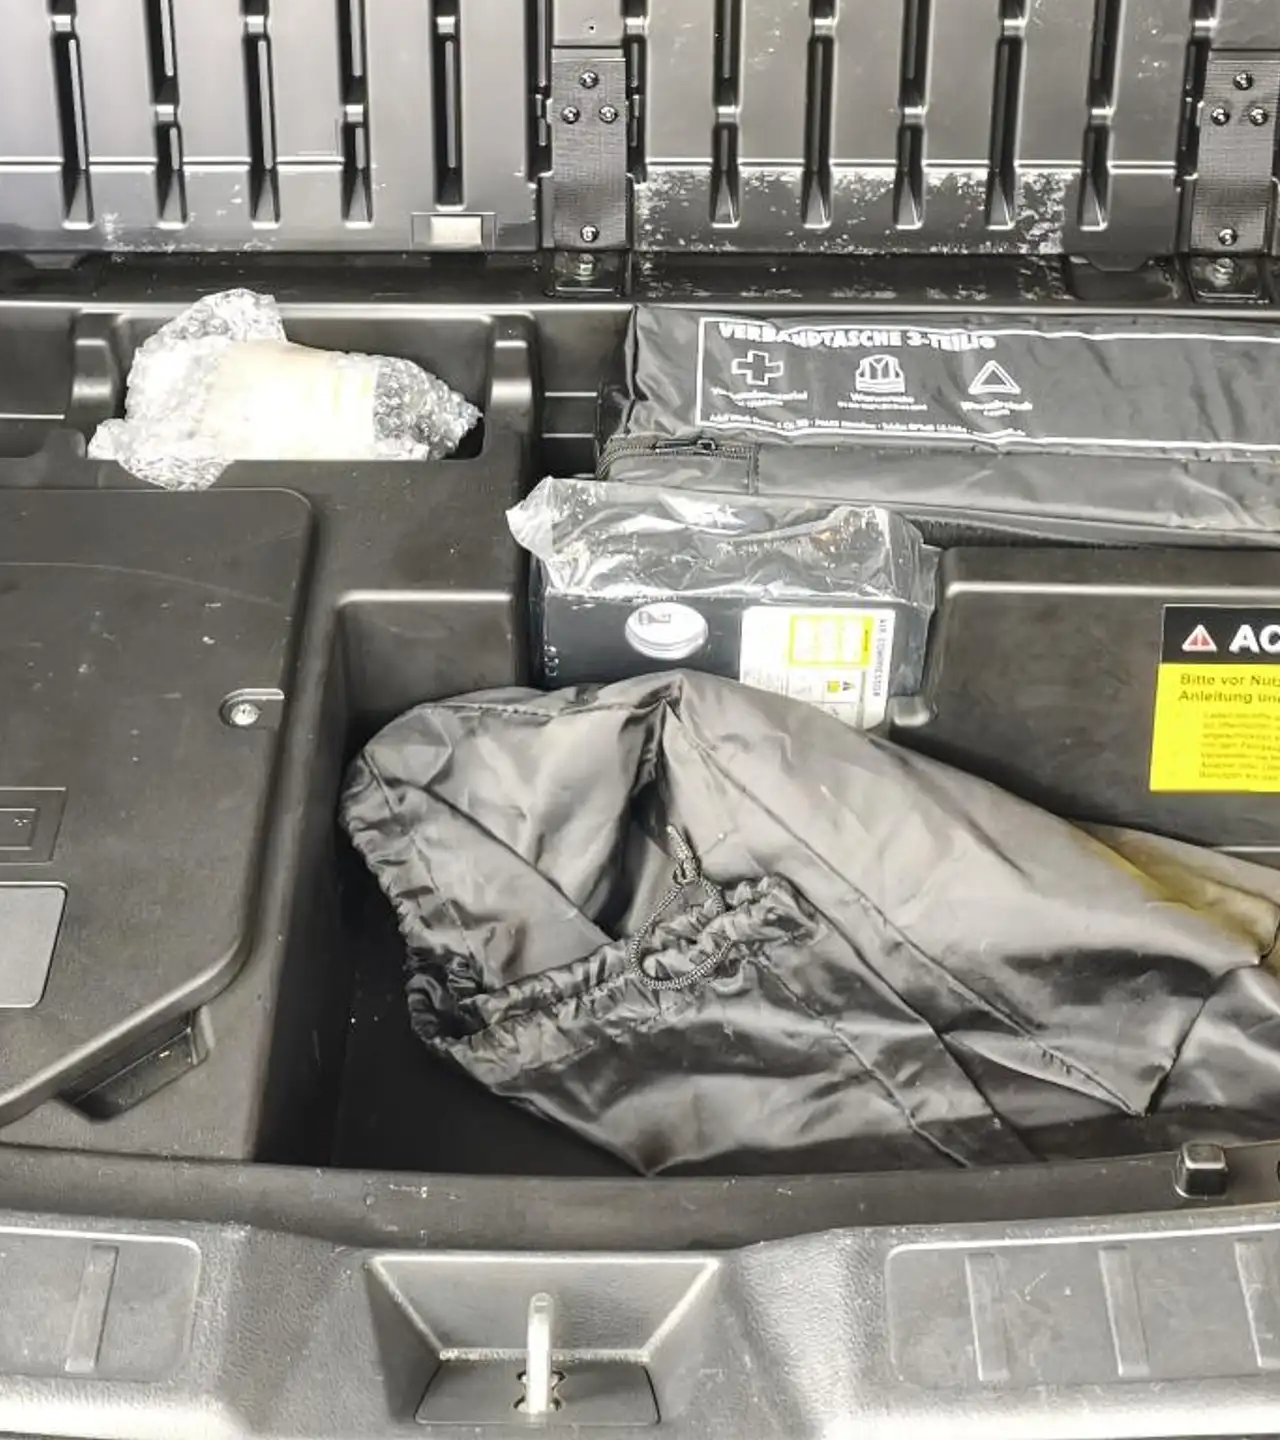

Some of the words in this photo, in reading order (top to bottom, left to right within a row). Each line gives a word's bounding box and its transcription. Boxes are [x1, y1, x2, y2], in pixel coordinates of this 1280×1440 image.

[1181, 673, 1215, 686] Bitte
[1221, 676, 1244, 686] vor
[1179, 690, 1253, 704] Anleitung
